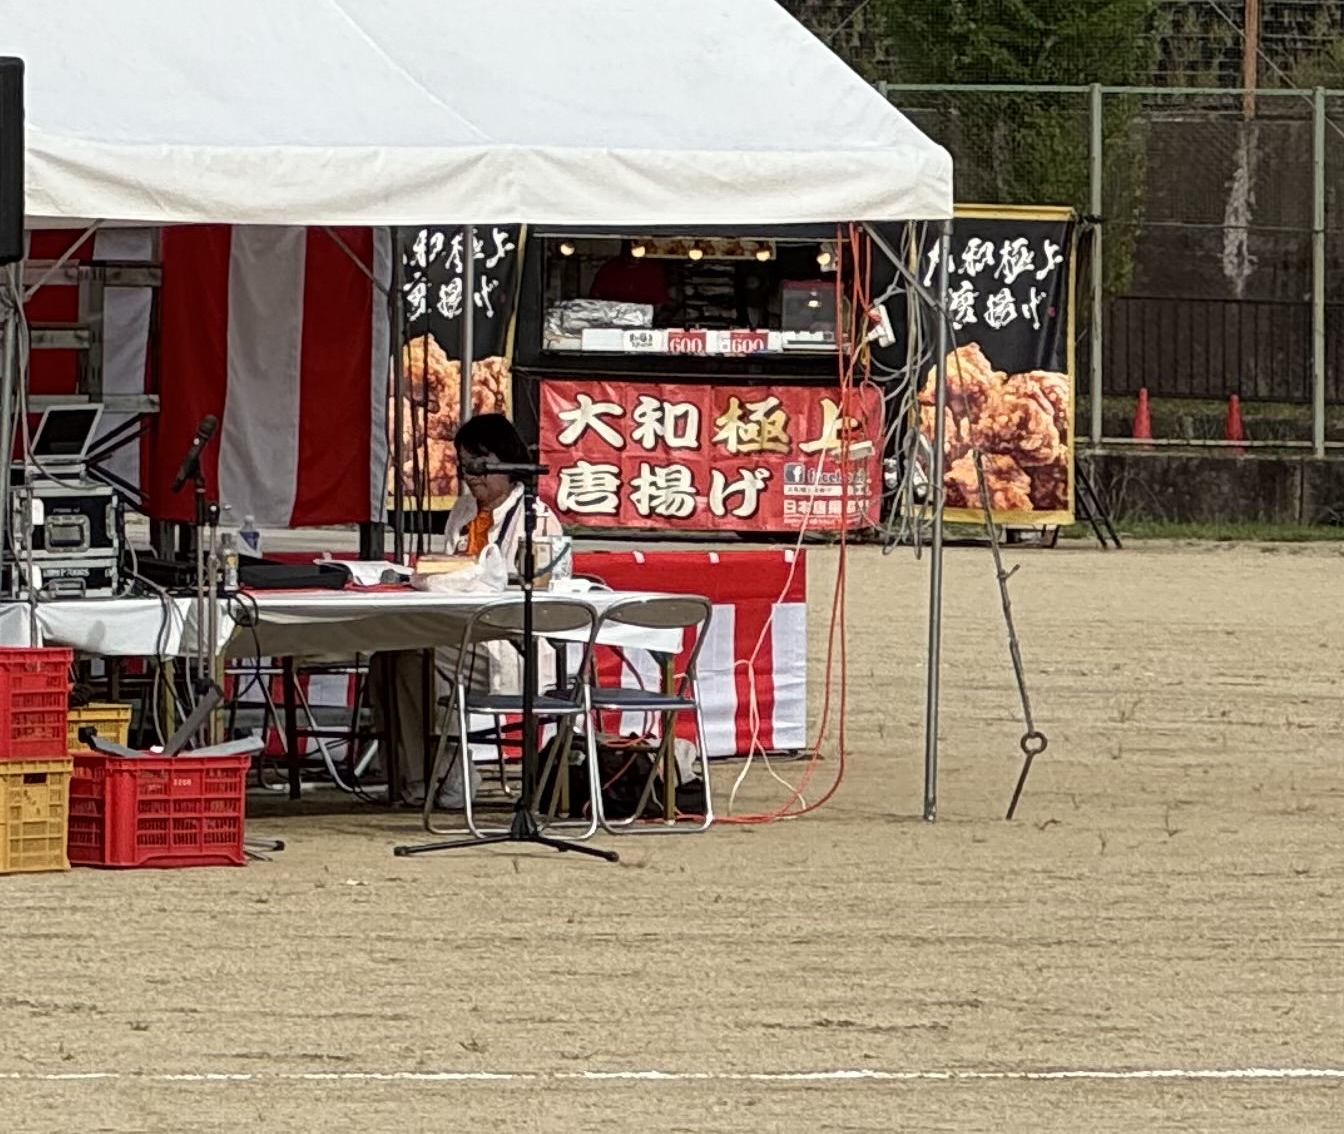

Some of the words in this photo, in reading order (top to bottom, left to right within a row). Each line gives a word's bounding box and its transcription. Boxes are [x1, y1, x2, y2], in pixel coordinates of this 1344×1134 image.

[558, 394, 874, 455] 大和極上
[557, 461, 774, 518] 唐揚げ
